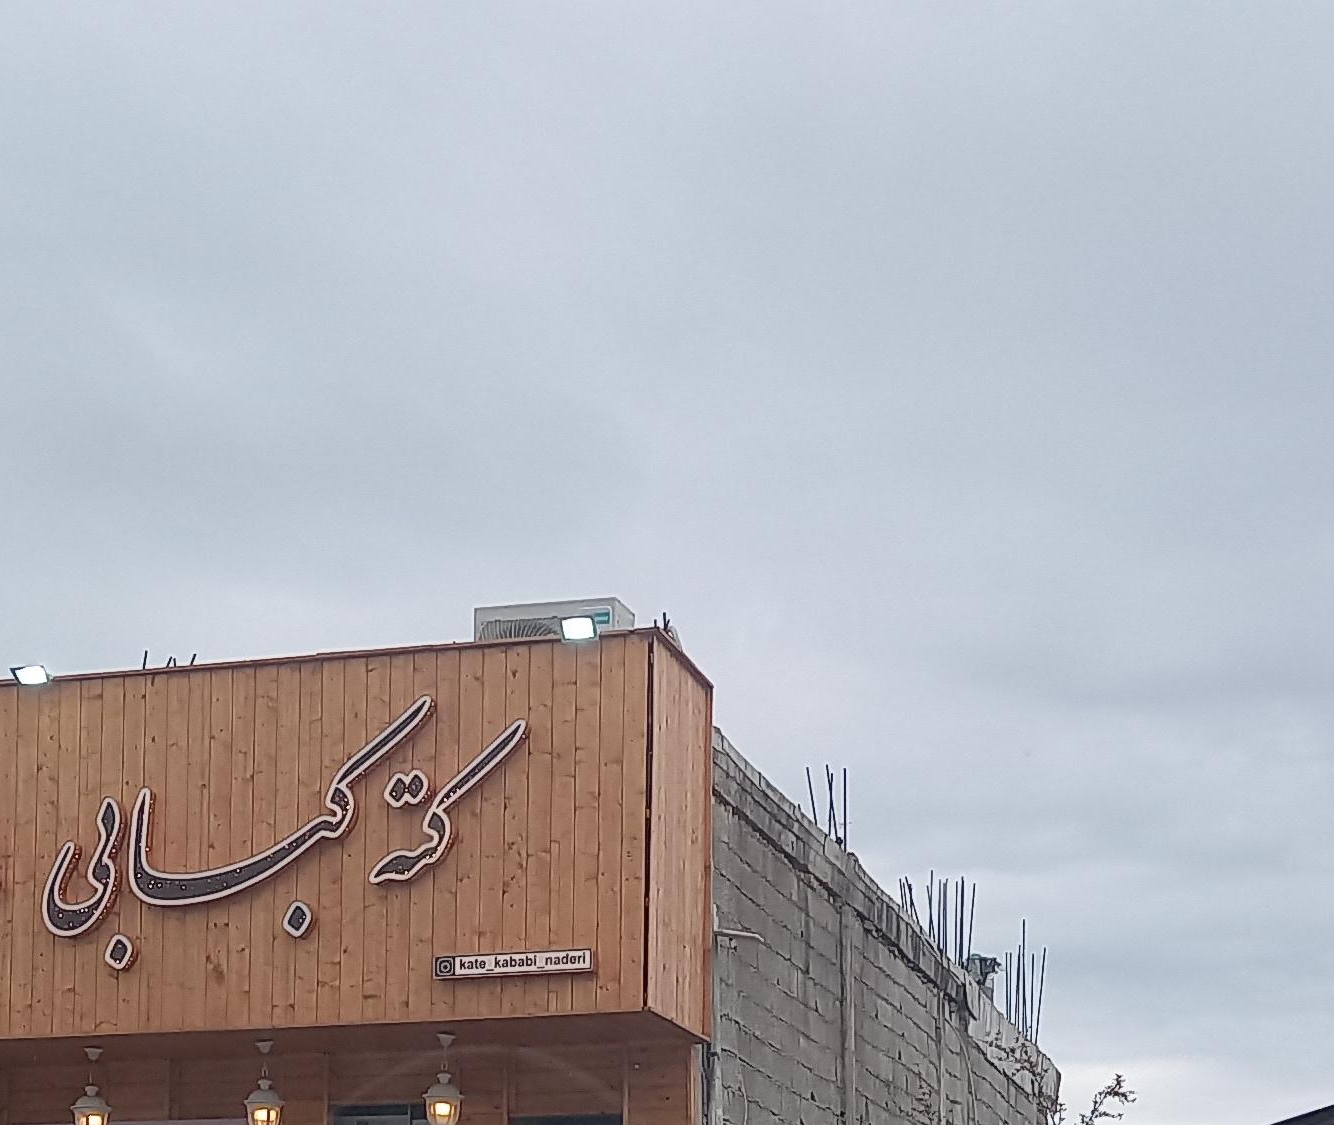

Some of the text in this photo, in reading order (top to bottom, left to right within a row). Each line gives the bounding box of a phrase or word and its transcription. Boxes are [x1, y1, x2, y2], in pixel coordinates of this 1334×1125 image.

[42, 694, 528, 971] کته کبابی
[459, 952, 586, 972] kate_kababi_naderi
